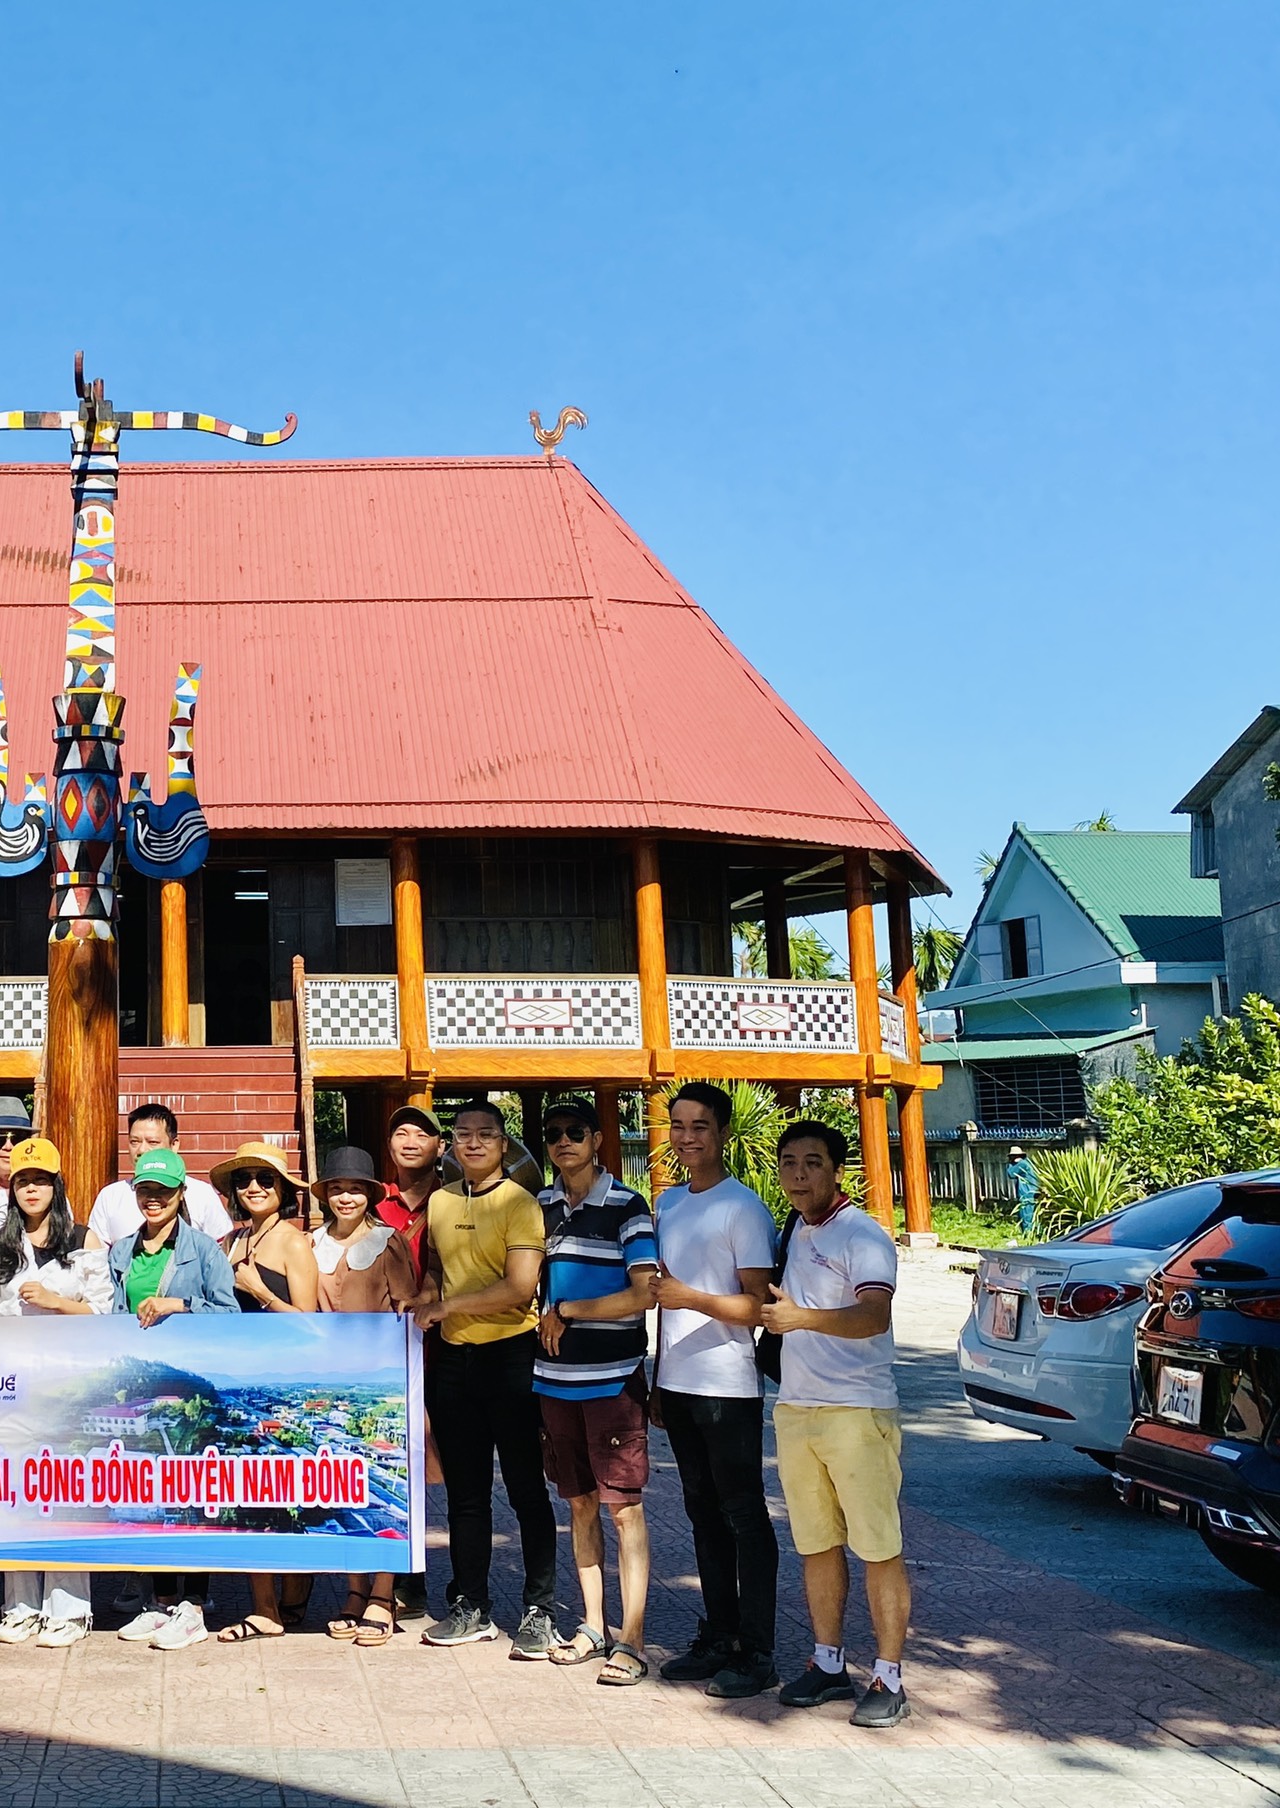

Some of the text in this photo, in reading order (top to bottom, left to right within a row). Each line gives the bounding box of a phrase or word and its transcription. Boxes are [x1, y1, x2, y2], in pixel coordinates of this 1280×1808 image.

[24, 1449, 85, 1513] CỘNG
[91, 1443, 154, 1504] ĐỒNG
[161, 1450, 235, 1513] HUYỆN
[242, 1459, 295, 1503] NAM
[302, 1449, 365, 1504] ĐÔNG
